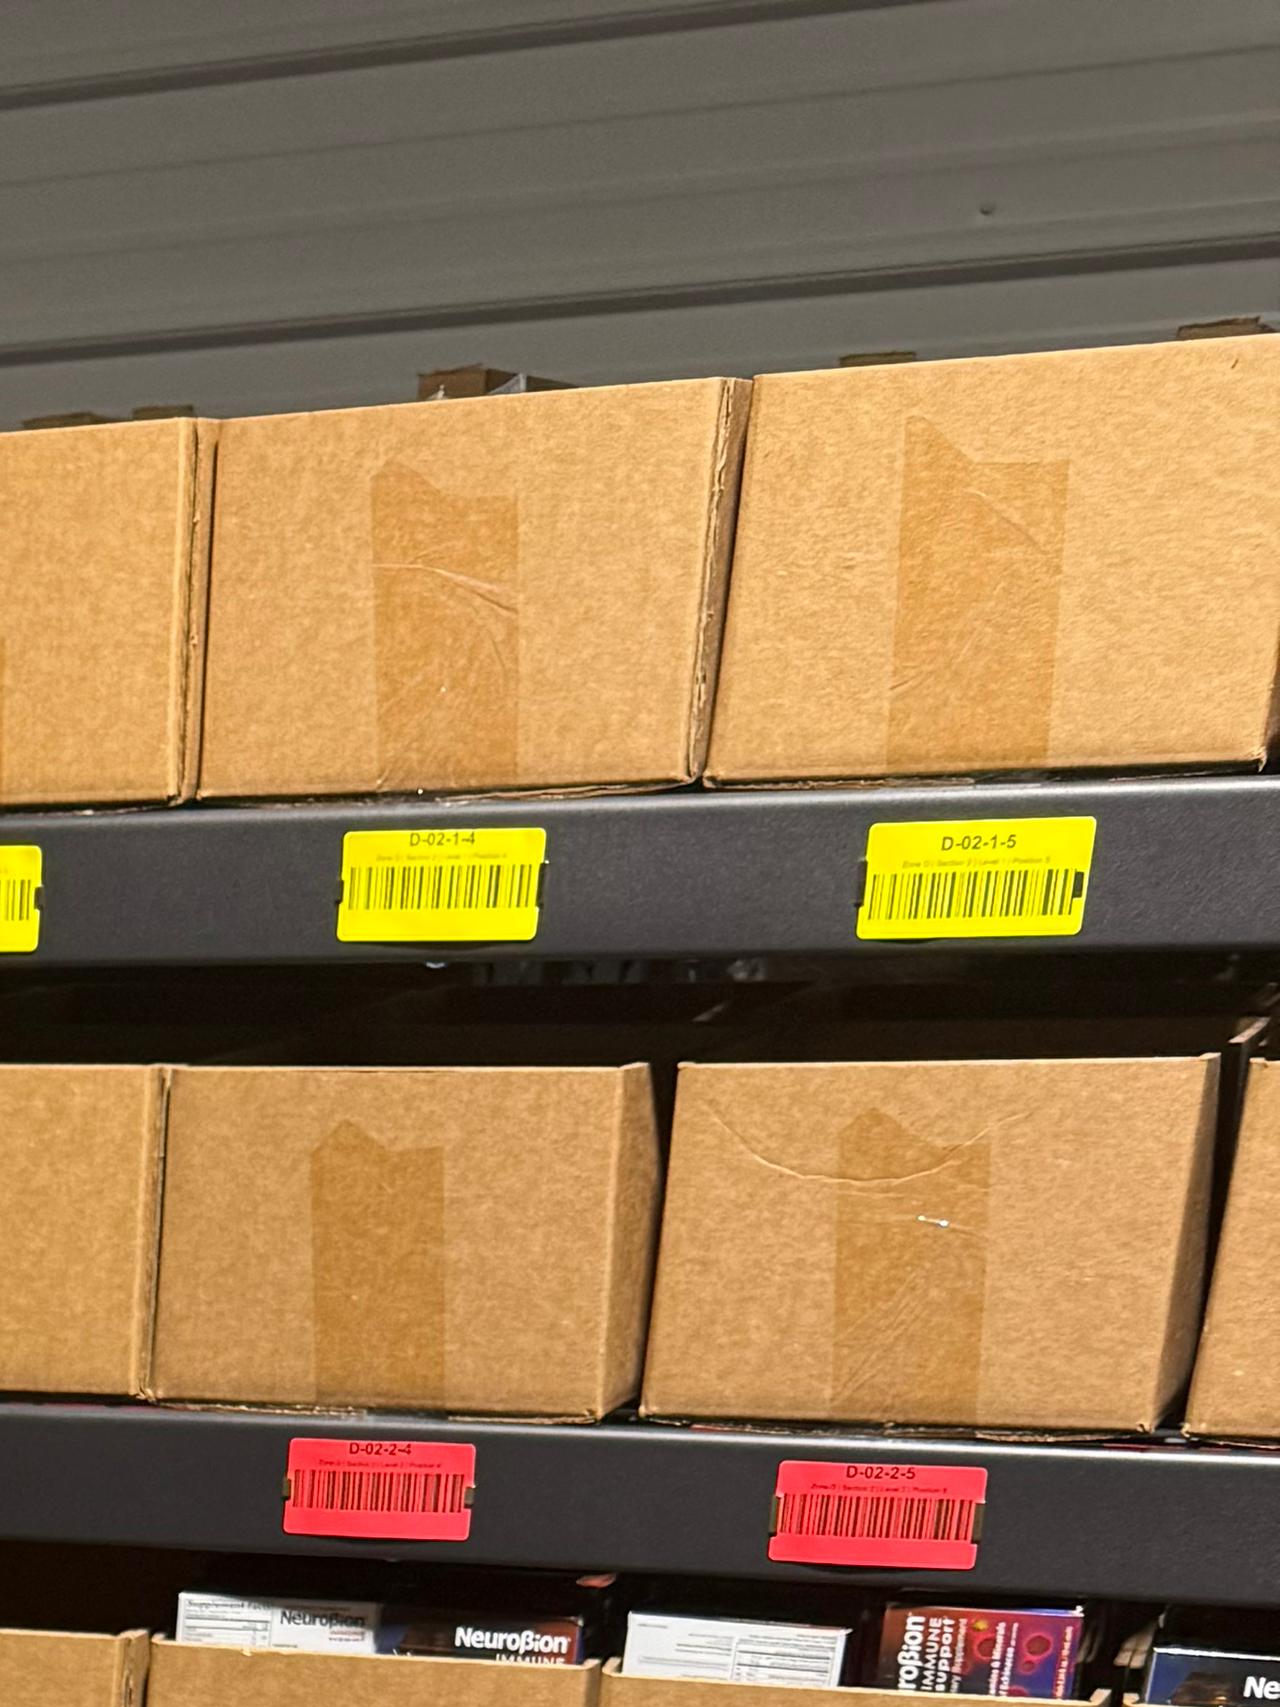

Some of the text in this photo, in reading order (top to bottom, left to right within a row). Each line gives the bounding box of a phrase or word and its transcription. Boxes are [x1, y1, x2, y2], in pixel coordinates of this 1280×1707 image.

[409, 832, 476, 846] D-02-1-4
[941, 835, 1018, 851] D-02-1-5
[349, 1442, 412, 1456] D-02-2-4
[846, 1465, 916, 1480] D-02-2-5
[920, 1617, 943, 1691] IMMUNE
